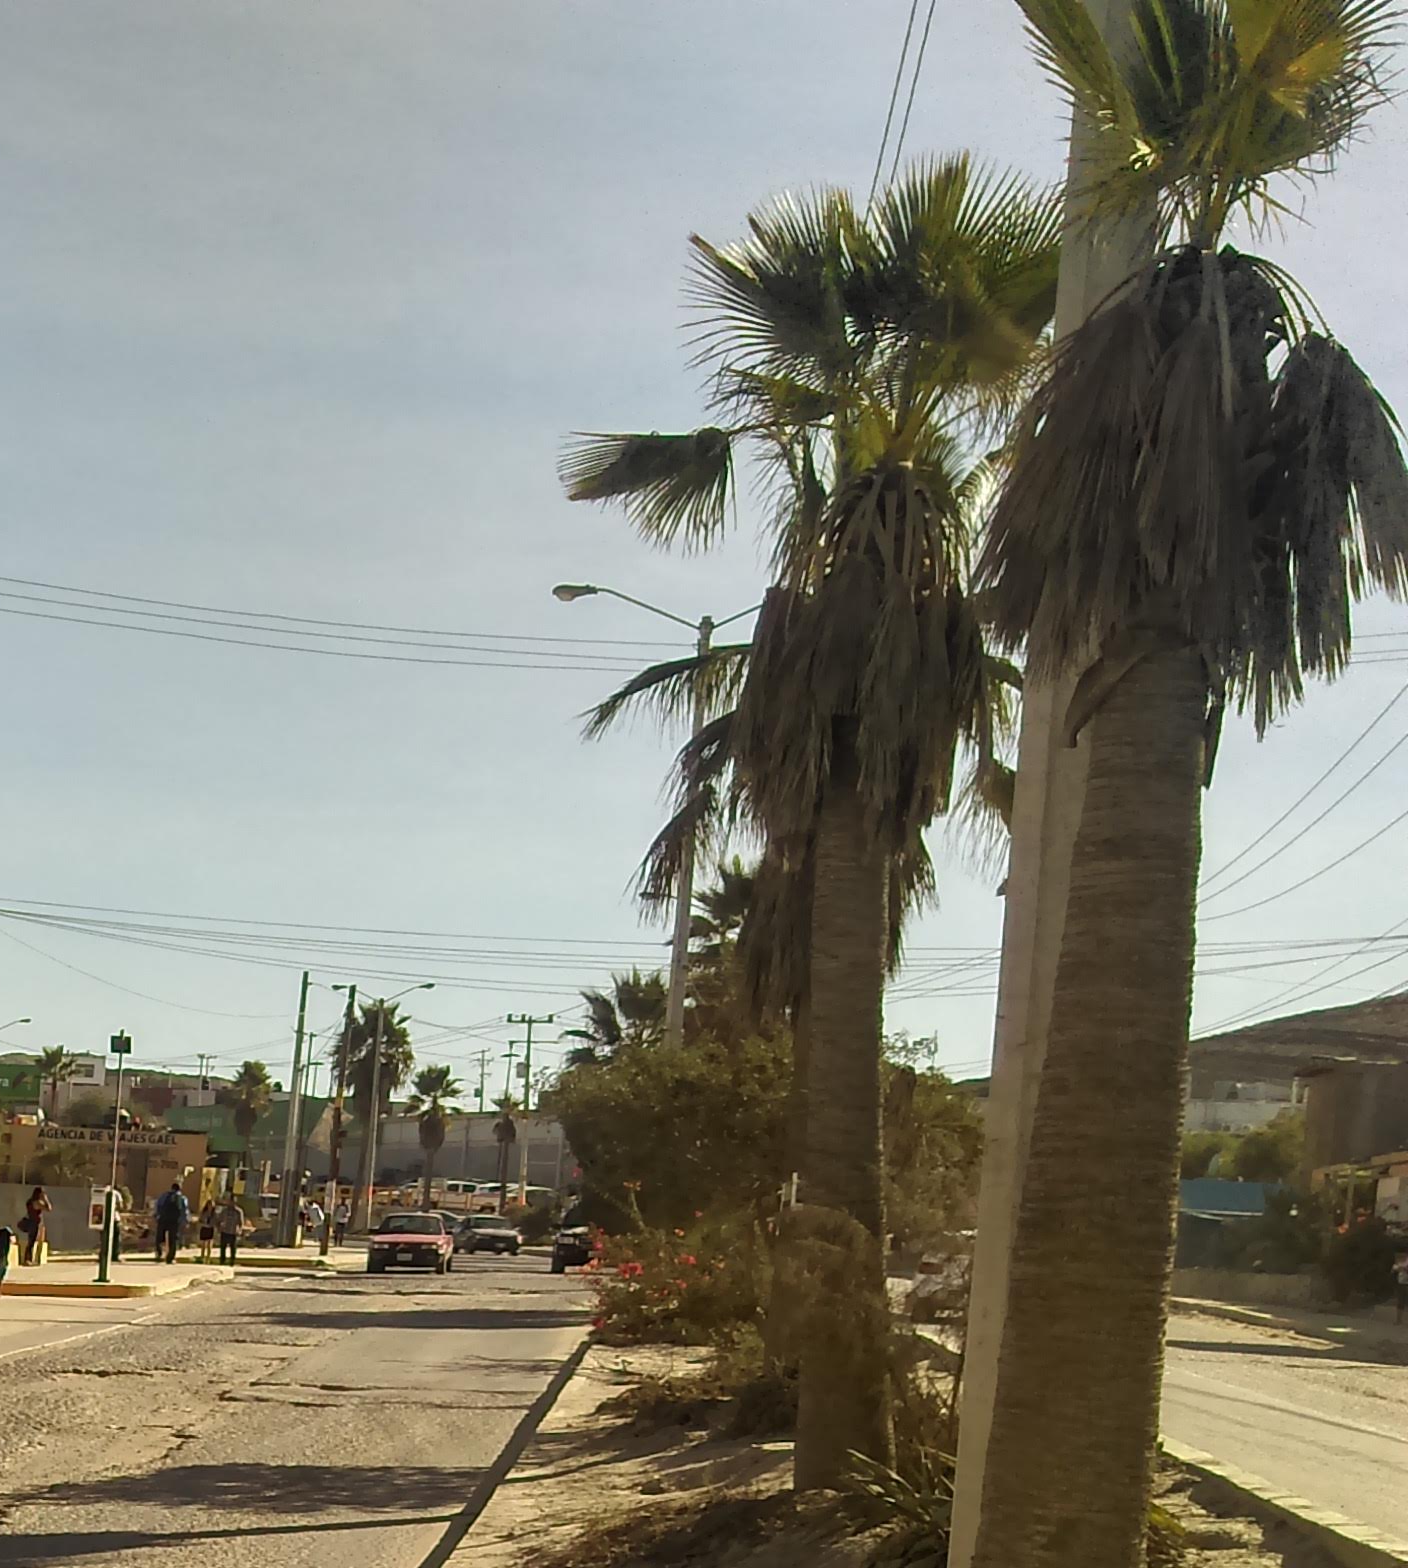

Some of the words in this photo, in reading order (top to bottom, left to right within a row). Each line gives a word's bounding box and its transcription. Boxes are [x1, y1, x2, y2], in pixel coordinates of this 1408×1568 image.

[38, 1128, 85, 1140] AGENCIA
[89, 1130, 103, 1141] DE
[107, 1131, 146, 1144] VAJES
